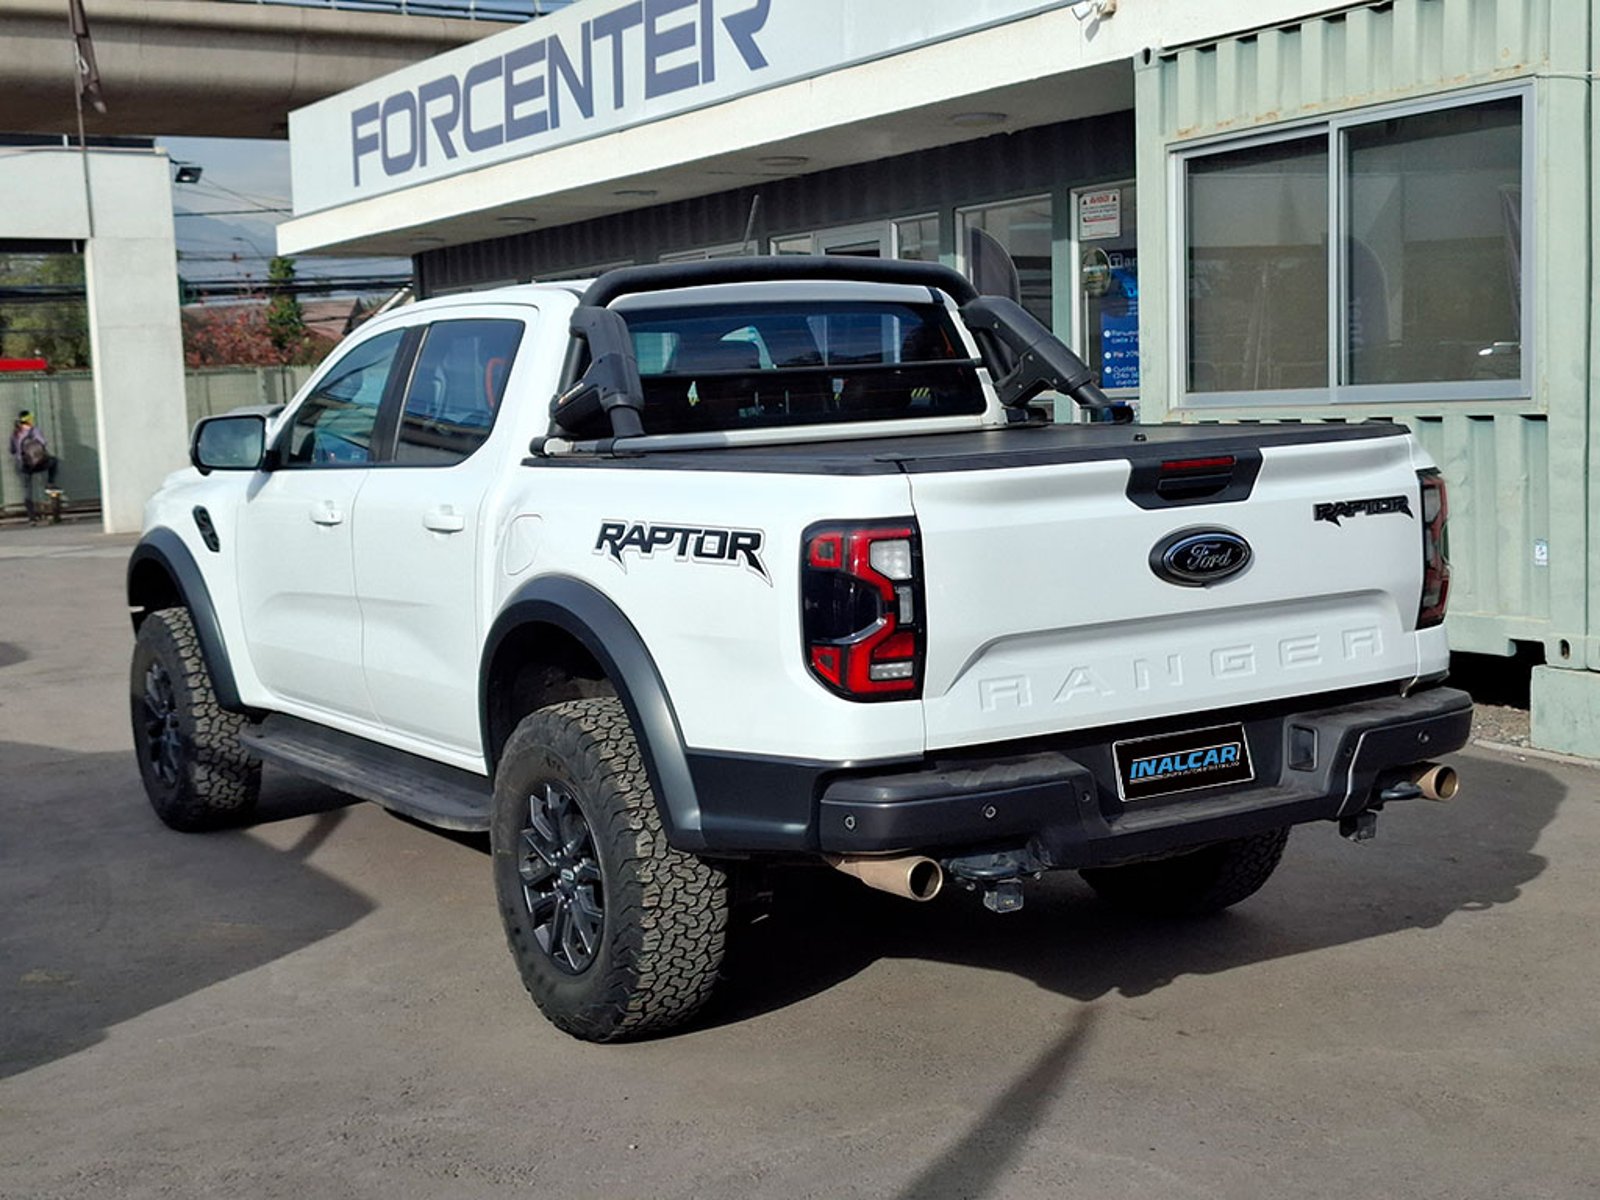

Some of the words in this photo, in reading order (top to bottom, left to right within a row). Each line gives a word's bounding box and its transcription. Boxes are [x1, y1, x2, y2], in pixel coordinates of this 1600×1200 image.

[351, 0, 770, 187] FORCENTER
[1313, 495, 1414, 527] RAPTOR
[594, 521, 770, 582] RAPTOR
[1187, 543, 1232, 570] Ford
[978, 625, 1385, 713] RANGER
[1130, 746, 1237, 779] INALCAR
